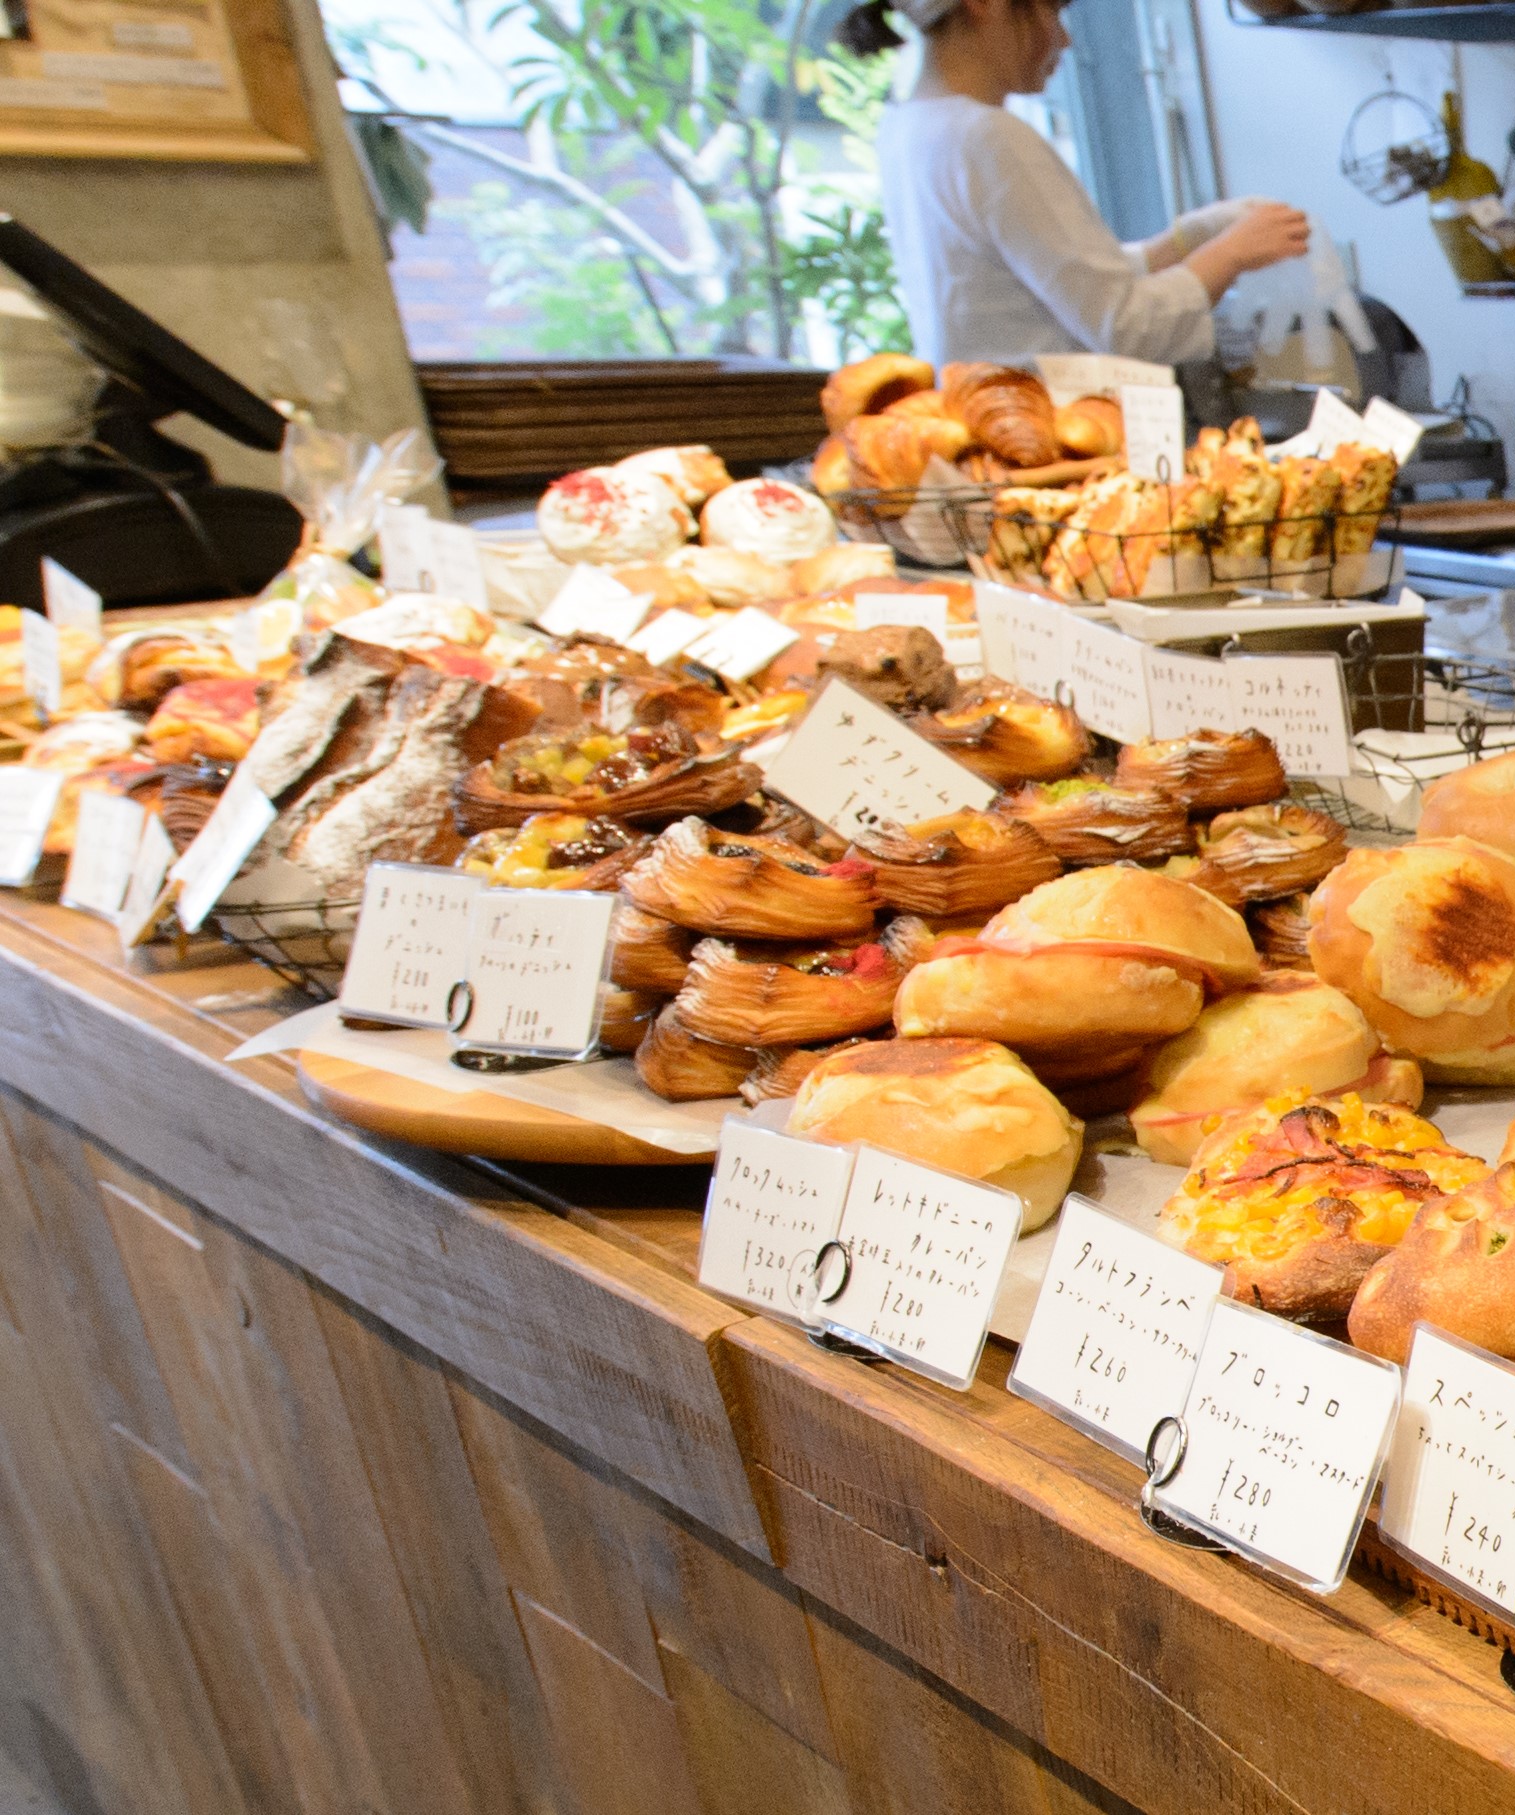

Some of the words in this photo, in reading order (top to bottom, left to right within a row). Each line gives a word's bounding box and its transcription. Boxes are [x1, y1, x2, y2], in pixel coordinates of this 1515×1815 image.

[730, 1157, 818, 1197] クロックムッシュ
[873, 1178, 993, 1233] レットキドニーの
[743, 1240, 785, 1272] ¥320
[911, 1233, 987, 1270] カレーパン
[1074, 1242, 1195, 1311] タルトフランベ
[879, 1280, 924, 1317] ¥280
[1075, 1332, 1126, 1383] ¥260
[1221, 1352, 1340, 1418] ブロッコロ
[1217, 1458, 1272, 1507] ¥280
[1444, 1491, 1502, 1552] ¥240
